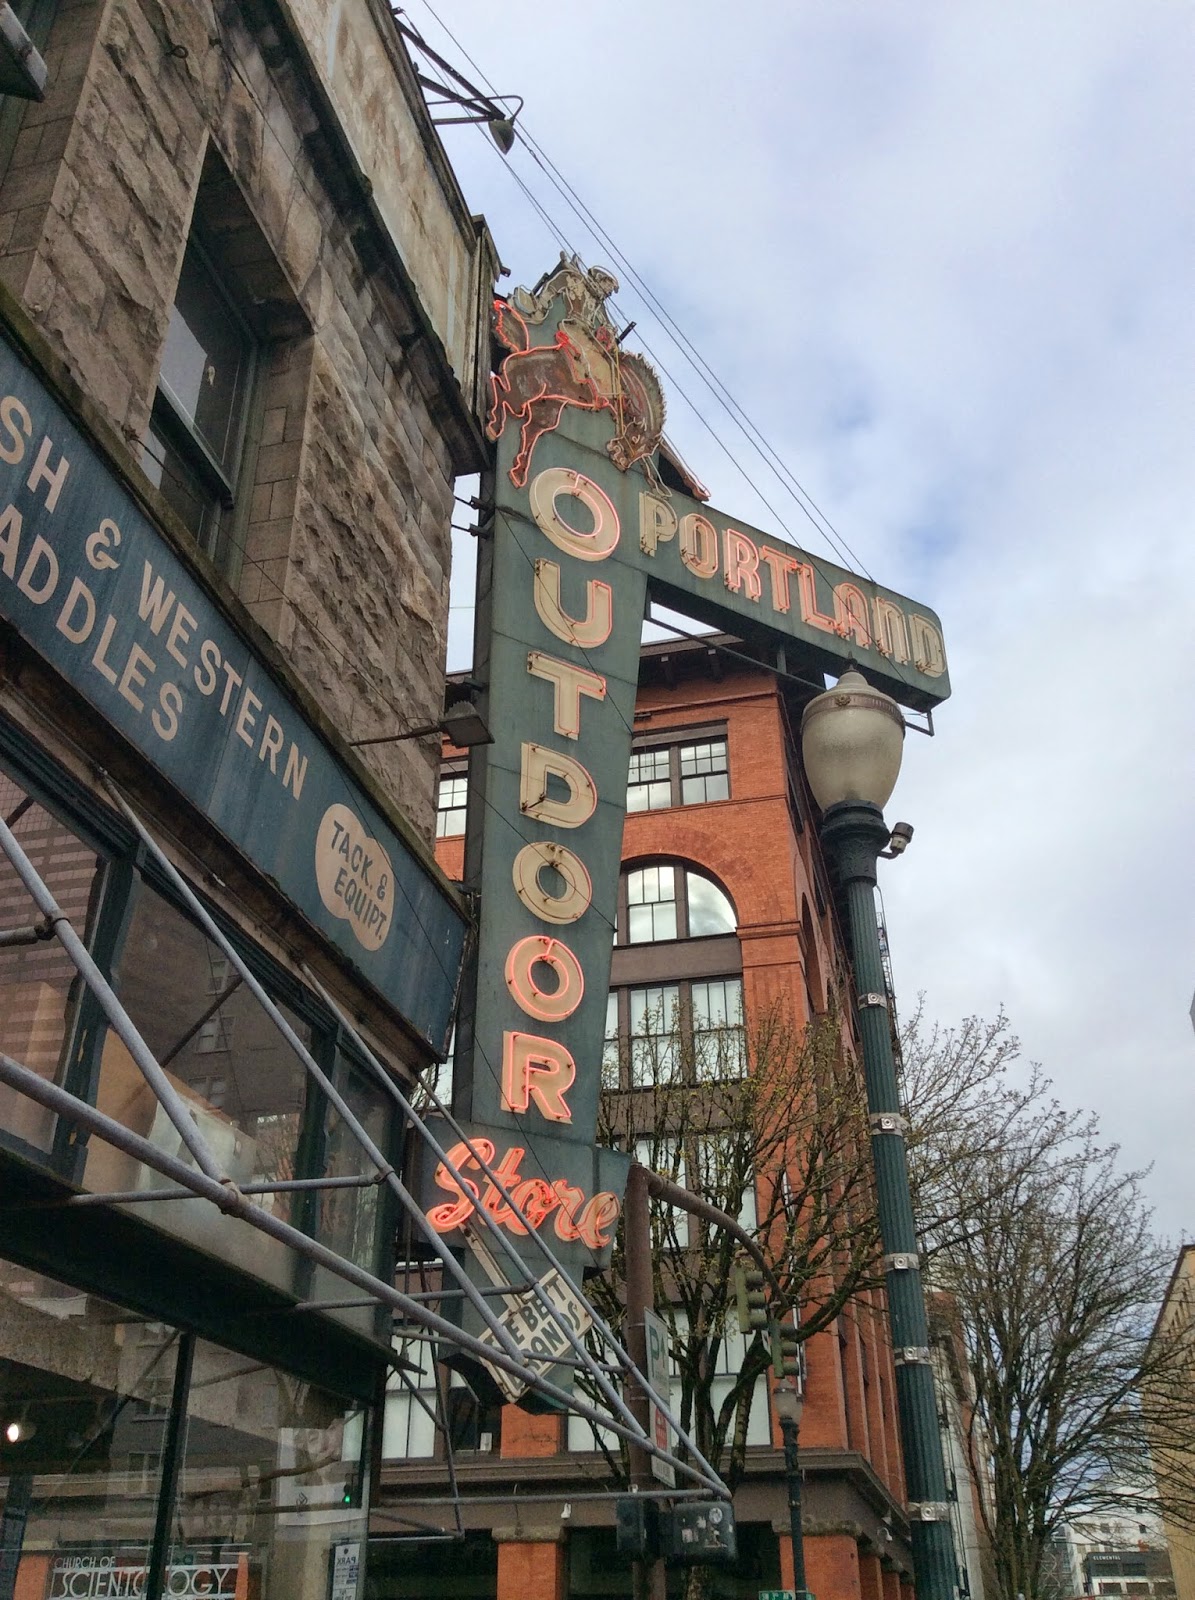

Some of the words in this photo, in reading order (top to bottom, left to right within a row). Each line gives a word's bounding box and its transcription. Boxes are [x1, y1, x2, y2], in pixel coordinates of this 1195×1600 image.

[638, 490, 947, 679] PORTLAND
[86, 518, 122, 570] &
[138, 559, 308, 801] WESTERN
[500, 466, 621, 1125] OUTDOOR
[376, 873, 388, 901] &
[425, 1137, 621, 1250] Store
[54, 1557, 96, 1569] CHURCH
[99, 1555, 116, 1568] OF
[58, 1567, 232, 1599] SCIENTOOGY
